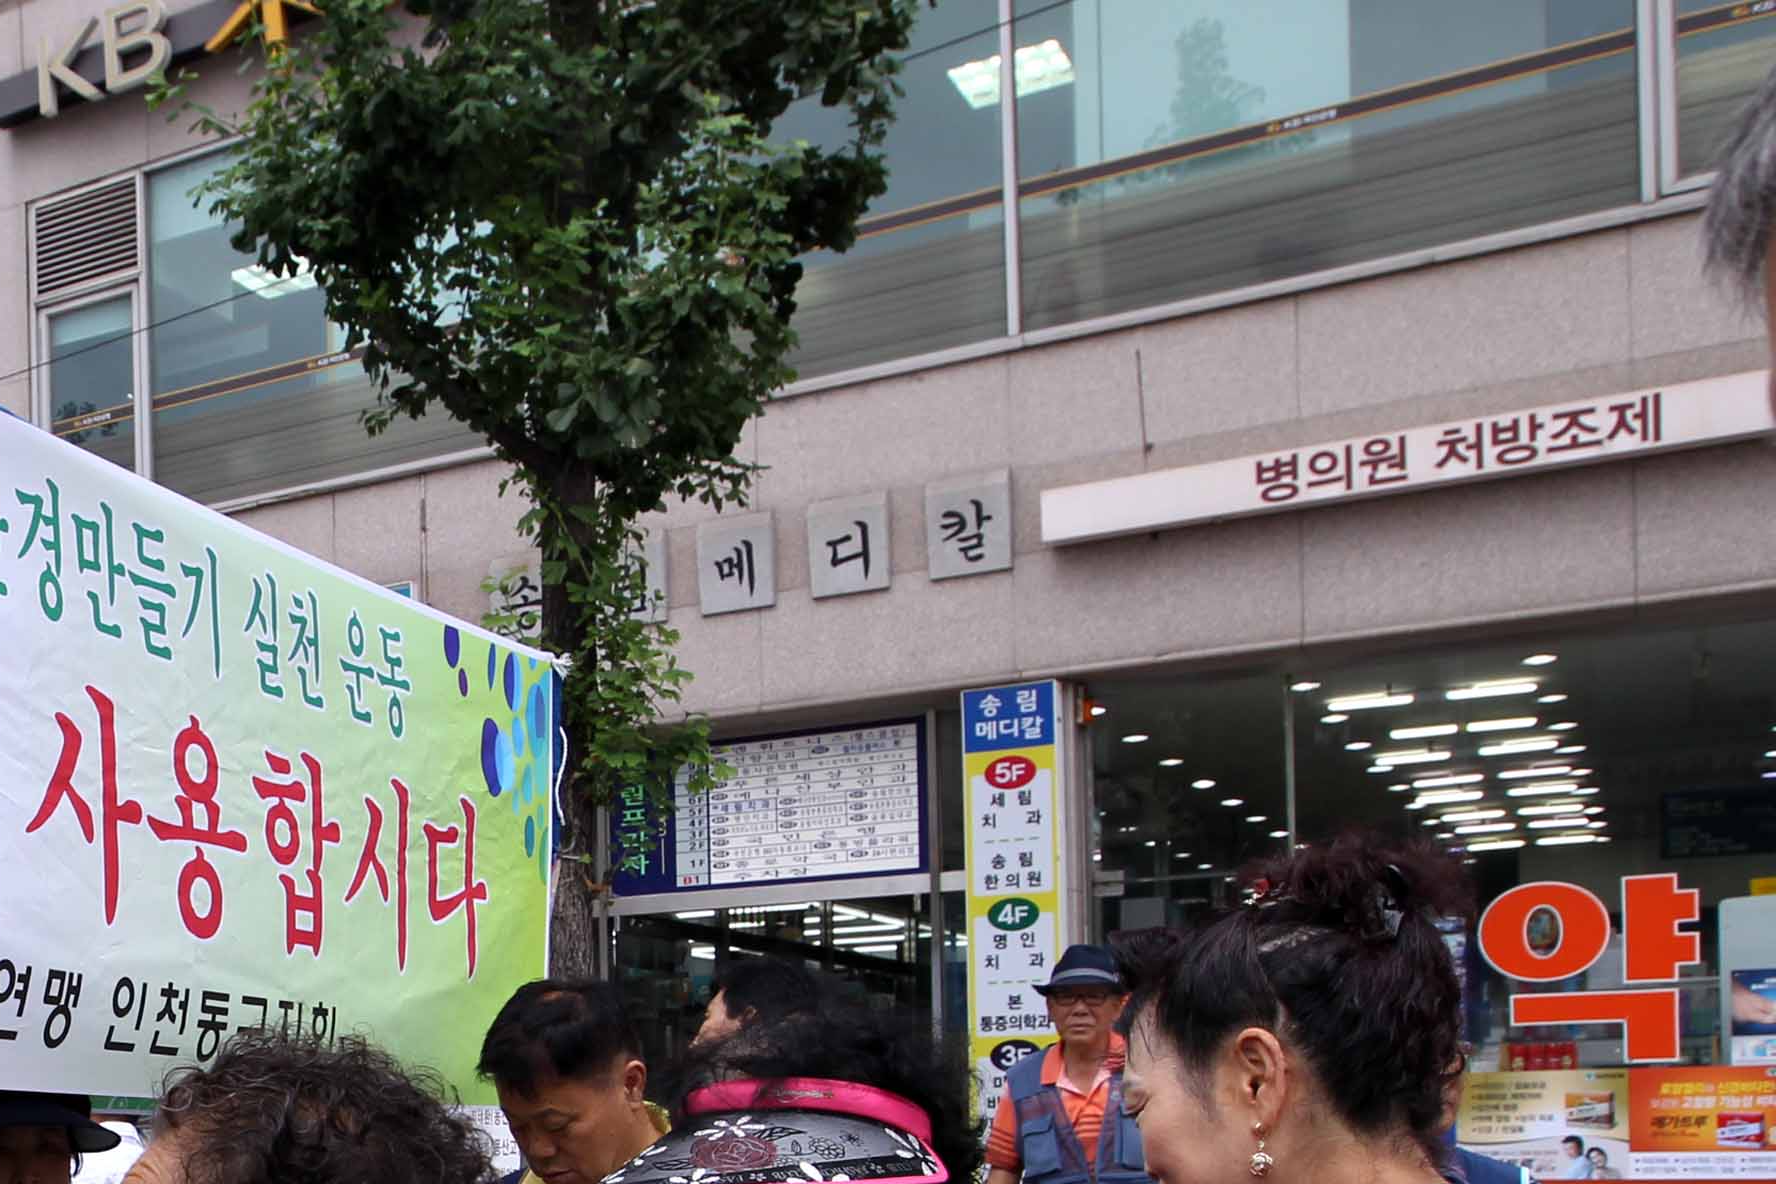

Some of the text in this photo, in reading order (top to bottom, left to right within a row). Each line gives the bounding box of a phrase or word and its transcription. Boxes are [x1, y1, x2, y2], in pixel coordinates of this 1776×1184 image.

[36, 0, 171, 118] KB
[1253, 392, 1664, 504] 병의원 처방조제
[242, 573, 325, 710] 실천
[339, 610, 411, 740] 운동
[979, 688, 1037, 717] 송림
[975, 715, 1044, 741] 메디칼
[994, 761, 1026, 783] 5F
[990, 789, 1032, 808] 세림
[981, 809, 1042, 829] 치과
[26, 684, 488, 980] 사용합시다
[991, 851, 1033, 870] 송림
[983, 870, 1042, 891] 한의원
[997, 903, 1029, 926] 4F
[993, 931, 1036, 950] 명인
[985, 953, 1045, 971] 치과
[1477, 871, 1701, 1064] 약
[980, 1014, 1052, 1033] 통증의학과
